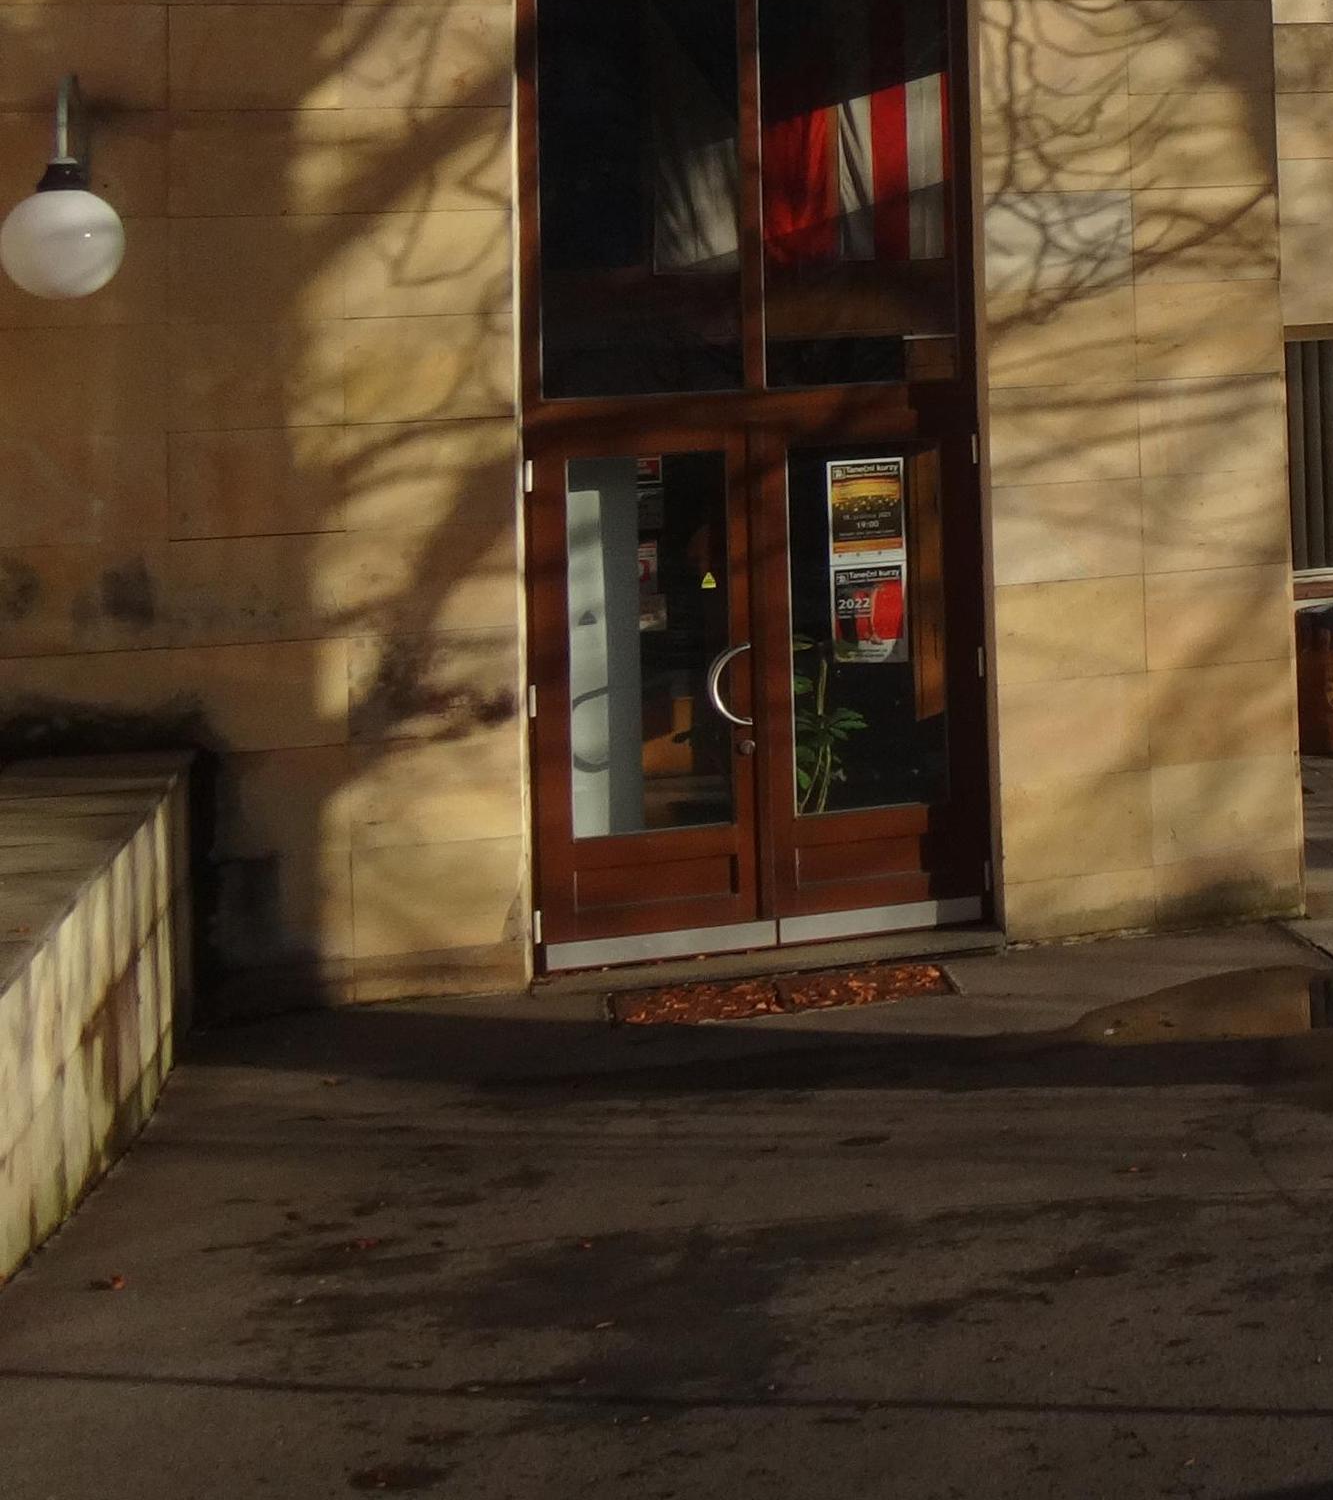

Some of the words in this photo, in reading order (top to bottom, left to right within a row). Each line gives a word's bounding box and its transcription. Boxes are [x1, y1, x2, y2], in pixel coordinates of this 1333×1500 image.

[849, 570, 878, 579] Taneční
[878, 569, 899, 578] kurzy
[838, 598, 870, 610] 2022
